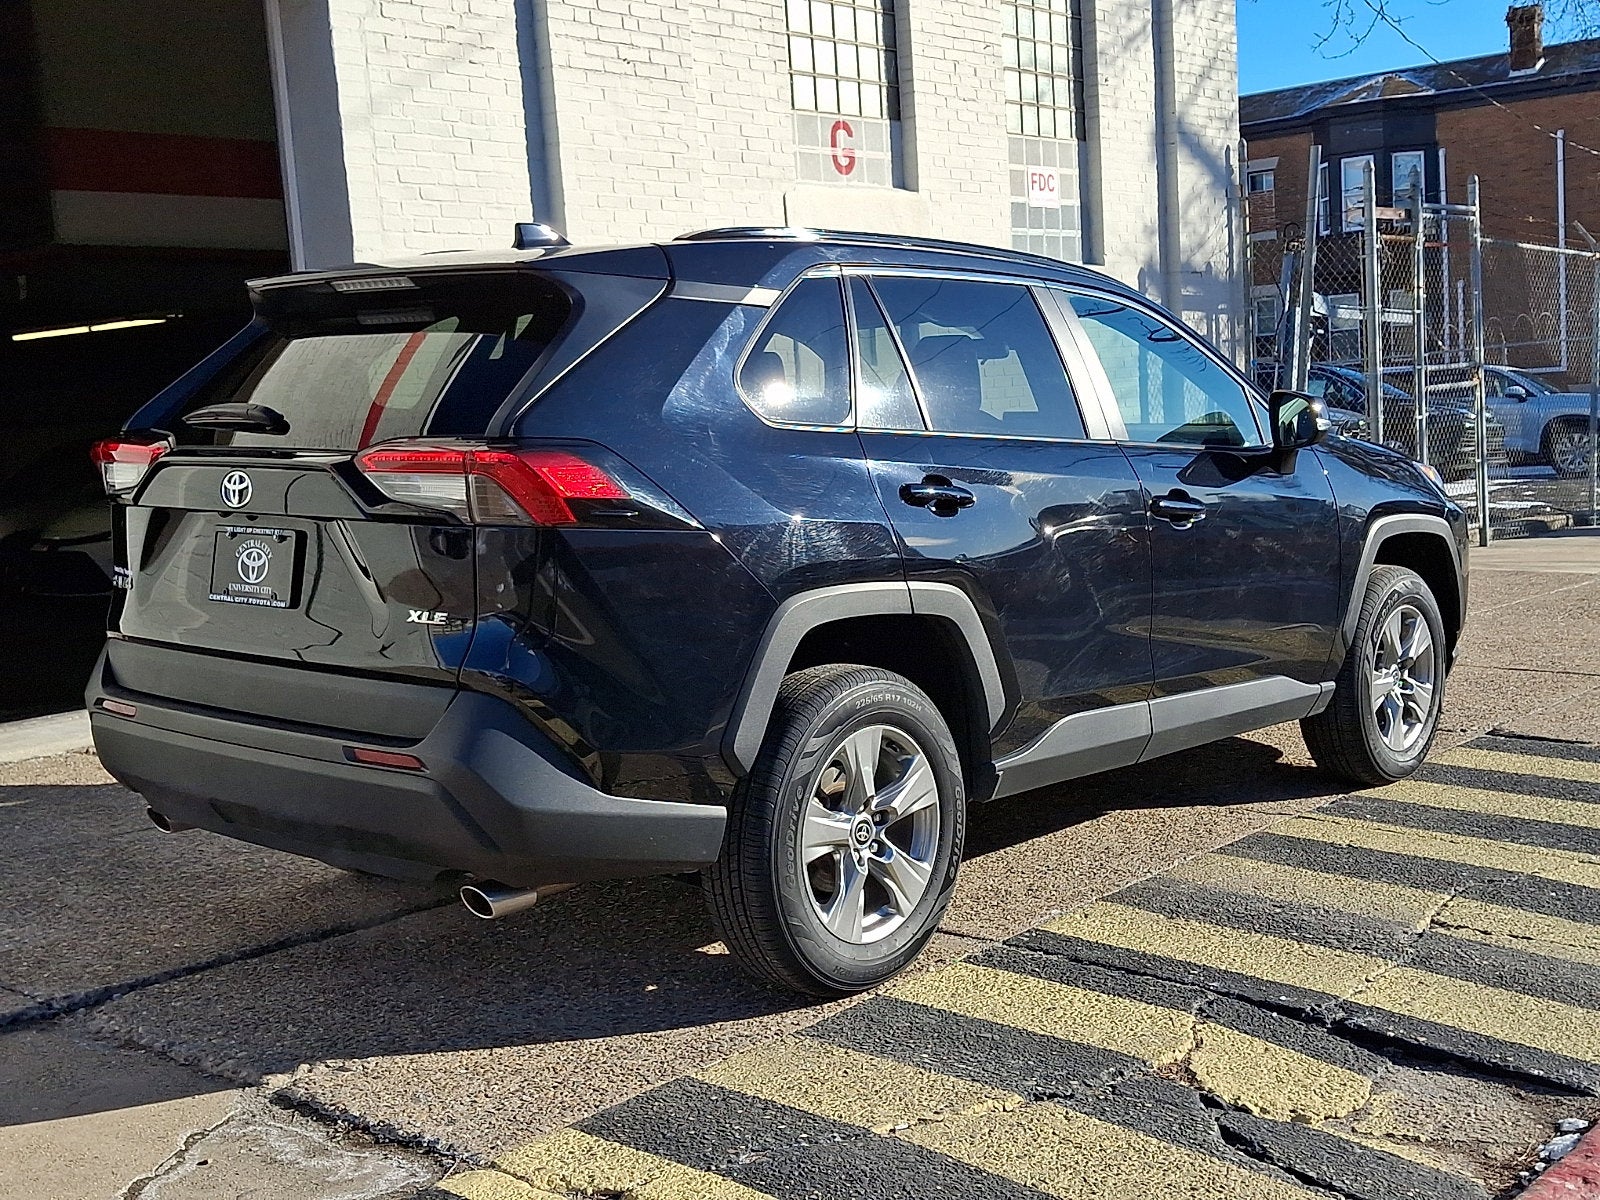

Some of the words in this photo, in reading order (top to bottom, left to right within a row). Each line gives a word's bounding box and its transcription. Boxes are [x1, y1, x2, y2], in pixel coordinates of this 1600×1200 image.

[831, 120, 856, 175] G
[1031, 172, 1055, 192] FDC
[235, 540, 260, 558] CENTRAL
[261, 542, 273, 559] CITY
[209, 594, 234, 602] CENTRAL
[228, 583, 260, 594] UNIVERSITY
[260, 586, 272, 595] CITY
[406, 609, 448, 625] XLE
[885, 693, 901, 702] R17
[902, 696, 922, 712] 102H
